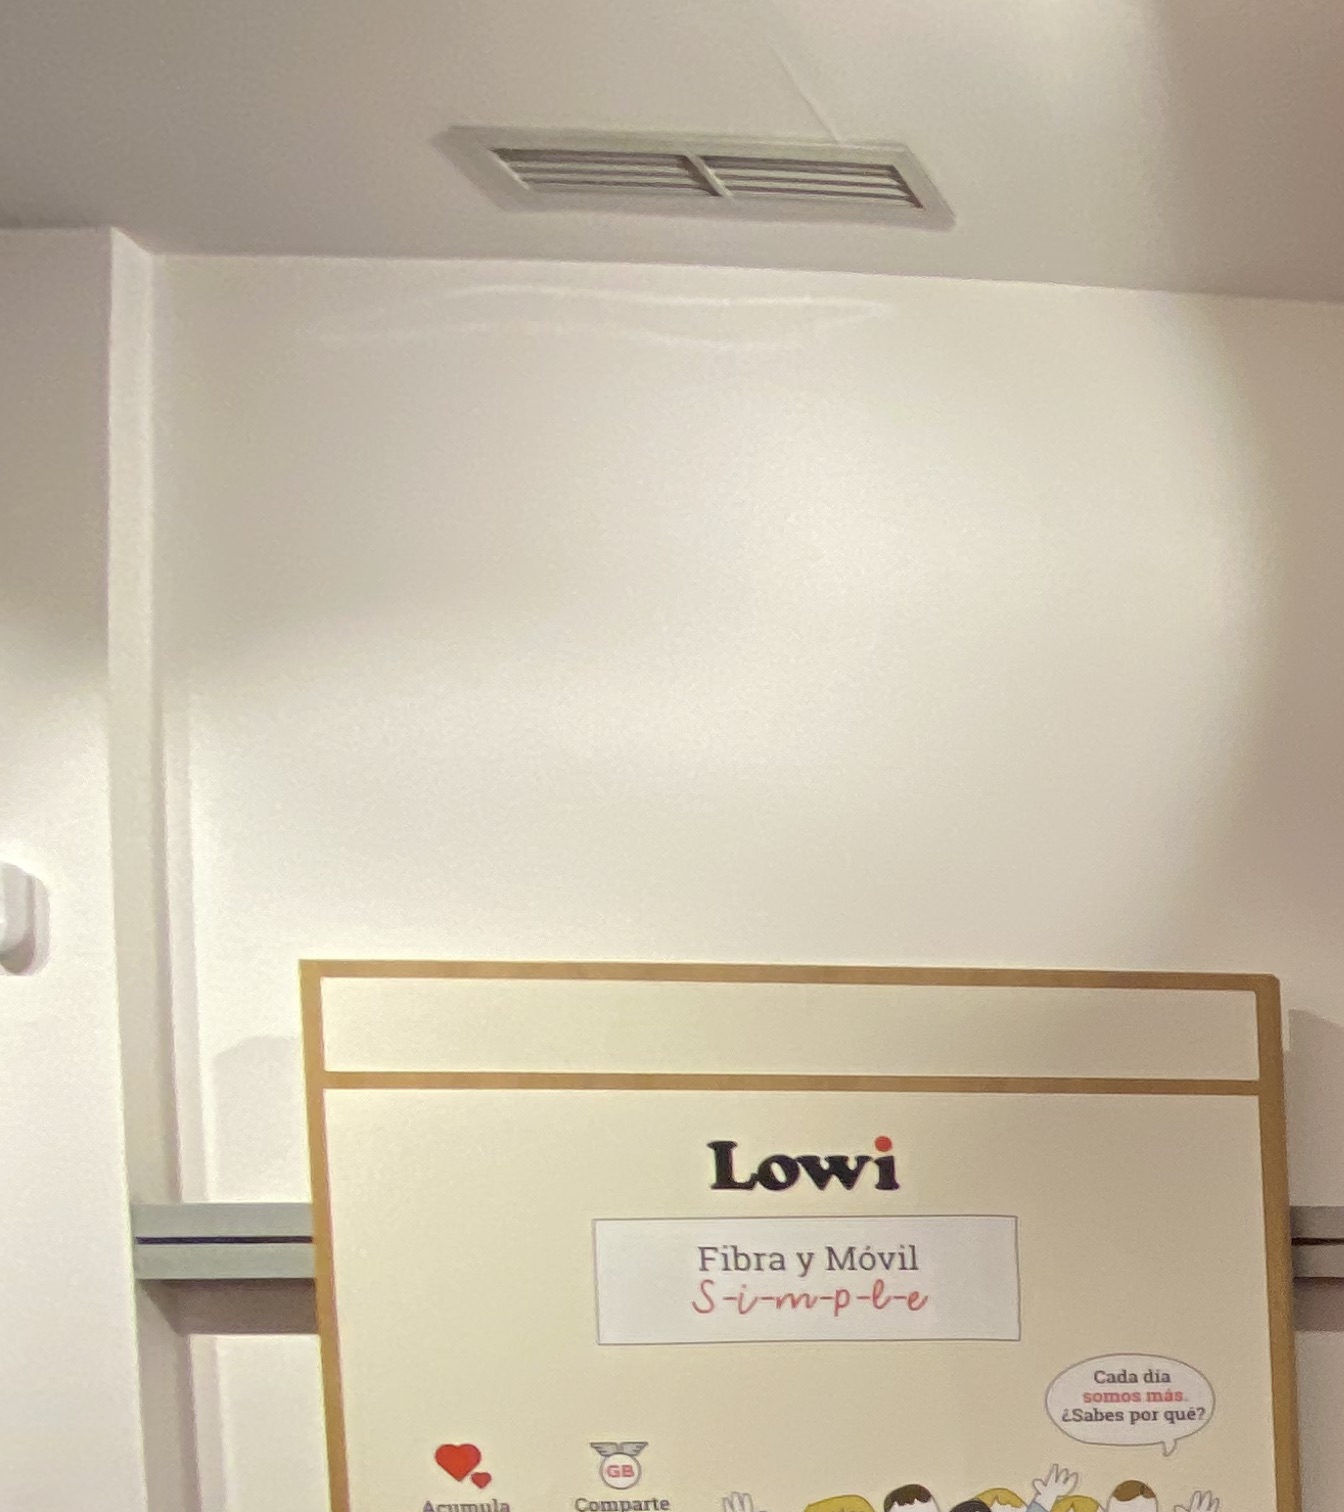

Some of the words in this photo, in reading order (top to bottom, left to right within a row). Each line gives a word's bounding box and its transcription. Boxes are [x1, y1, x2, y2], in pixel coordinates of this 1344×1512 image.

[707, 1135, 900, 1191] Lowi
[697, 1245, 787, 1272] Fibra
[796, 1251, 814, 1278] y
[825, 1244, 920, 1272] Móvil
[1093, 1369, 1138, 1384] Cada
[1082, 1391, 1141, 1404] somos
[1062, 1408, 1124, 1423] ¿Sabes
[1130, 1410, 1160, 1425] por
[1163, 1407, 1206, 1425] qué?
[606, 1464, 635, 1478] GB
